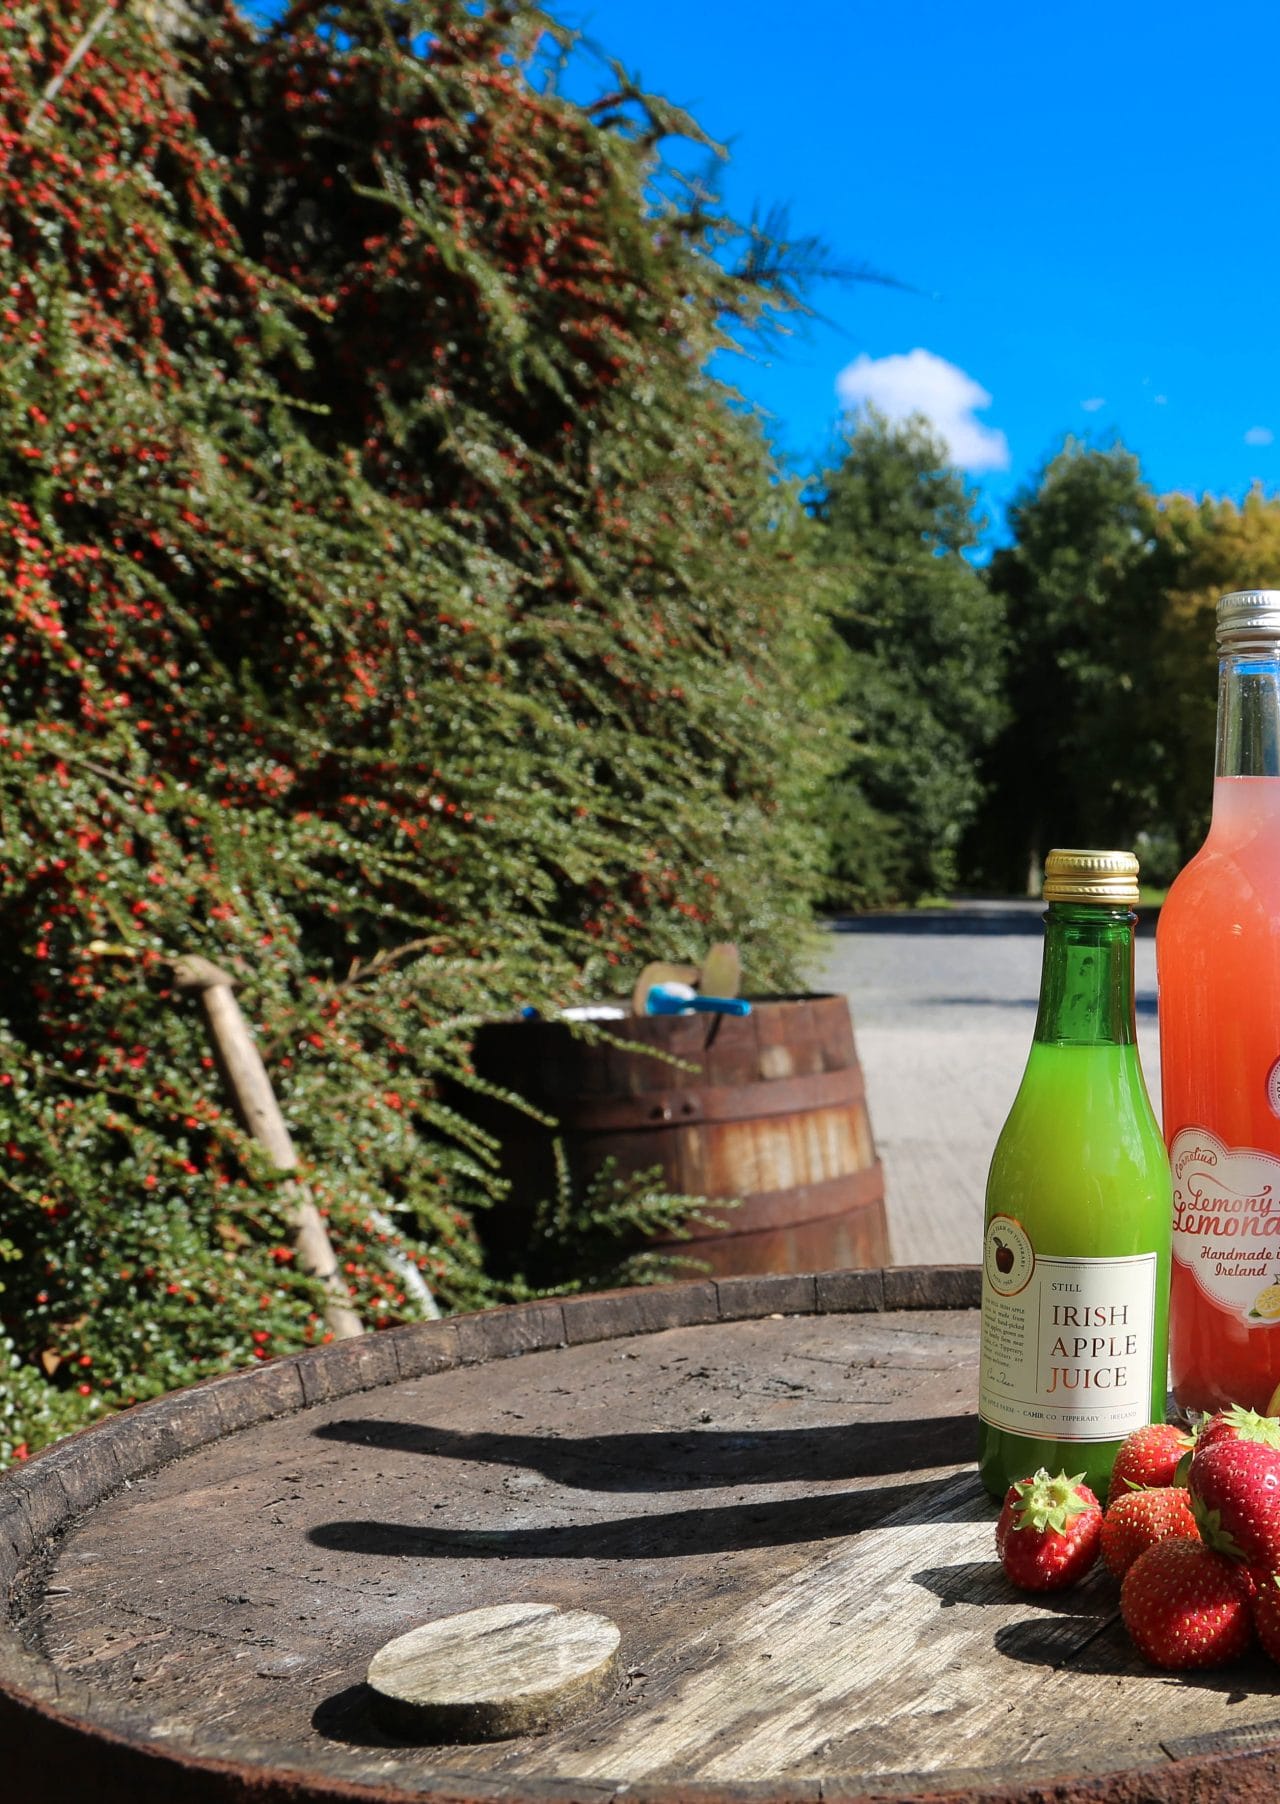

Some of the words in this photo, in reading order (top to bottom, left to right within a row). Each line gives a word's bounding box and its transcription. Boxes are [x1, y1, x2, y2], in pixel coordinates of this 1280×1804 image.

[1200, 1246, 1273, 1260] Handmade
[1214, 1262, 1268, 1276] Ireland
[1052, 1282, 1082, 1292] STILL
[1052, 1305, 1128, 1327] IRISH
[1050, 1335, 1137, 1357] APPLE
[1046, 1367, 1127, 1393] JUICE
[1023, 1410, 1044, 1420] CAHIR
[1110, 1411, 1136, 1421] IRELAND
